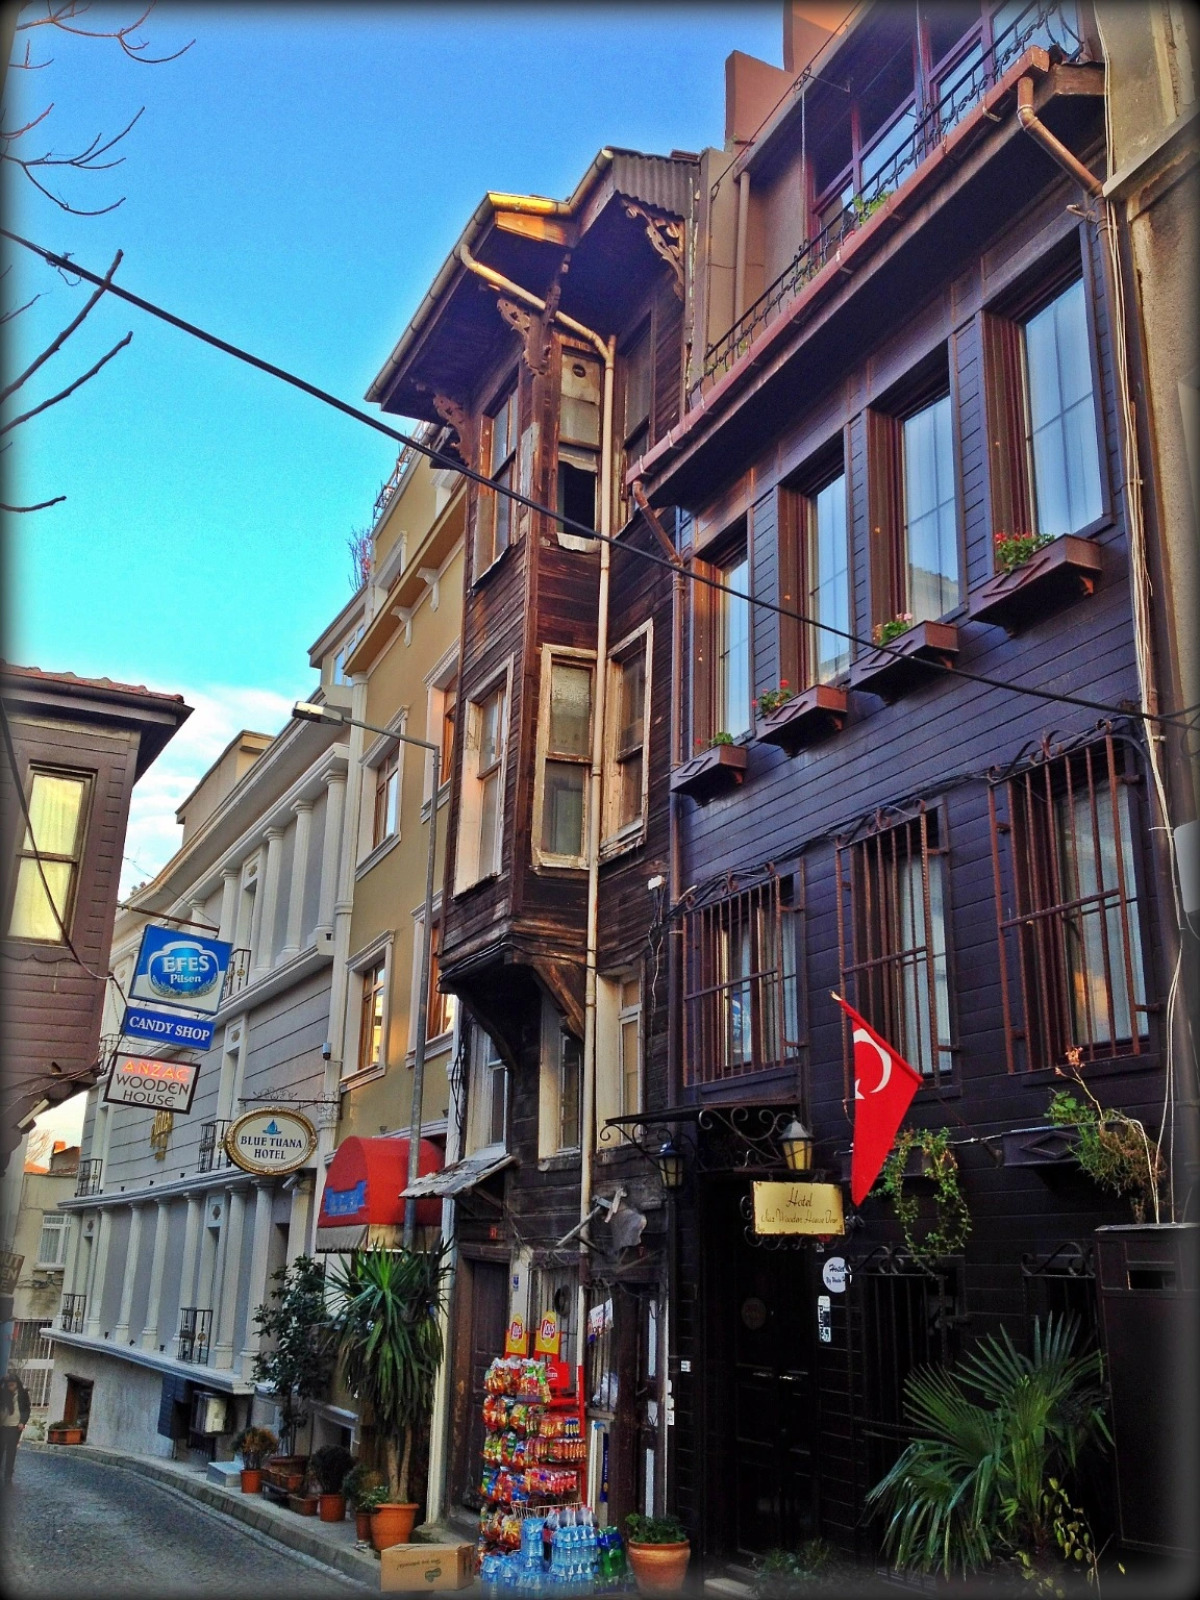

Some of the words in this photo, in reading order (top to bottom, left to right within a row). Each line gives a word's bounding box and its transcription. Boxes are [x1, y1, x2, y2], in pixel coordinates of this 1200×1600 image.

[162, 955, 209, 974] EFES
[170, 973, 202, 984] Pilsen
[129, 1016, 174, 1034] CANDY
[174, 1024, 211, 1041] SHOP
[122, 1060, 190, 1082] ANZAC
[116, 1073, 190, 1097] WOODEN
[122, 1091, 175, 1107] HOUSE
[240, 1135, 268, 1147] BLUE
[269, 1137, 303, 1149] TUANA
[254, 1147, 287, 1160] HOTEL
[786, 1187, 813, 1208] Hotel
